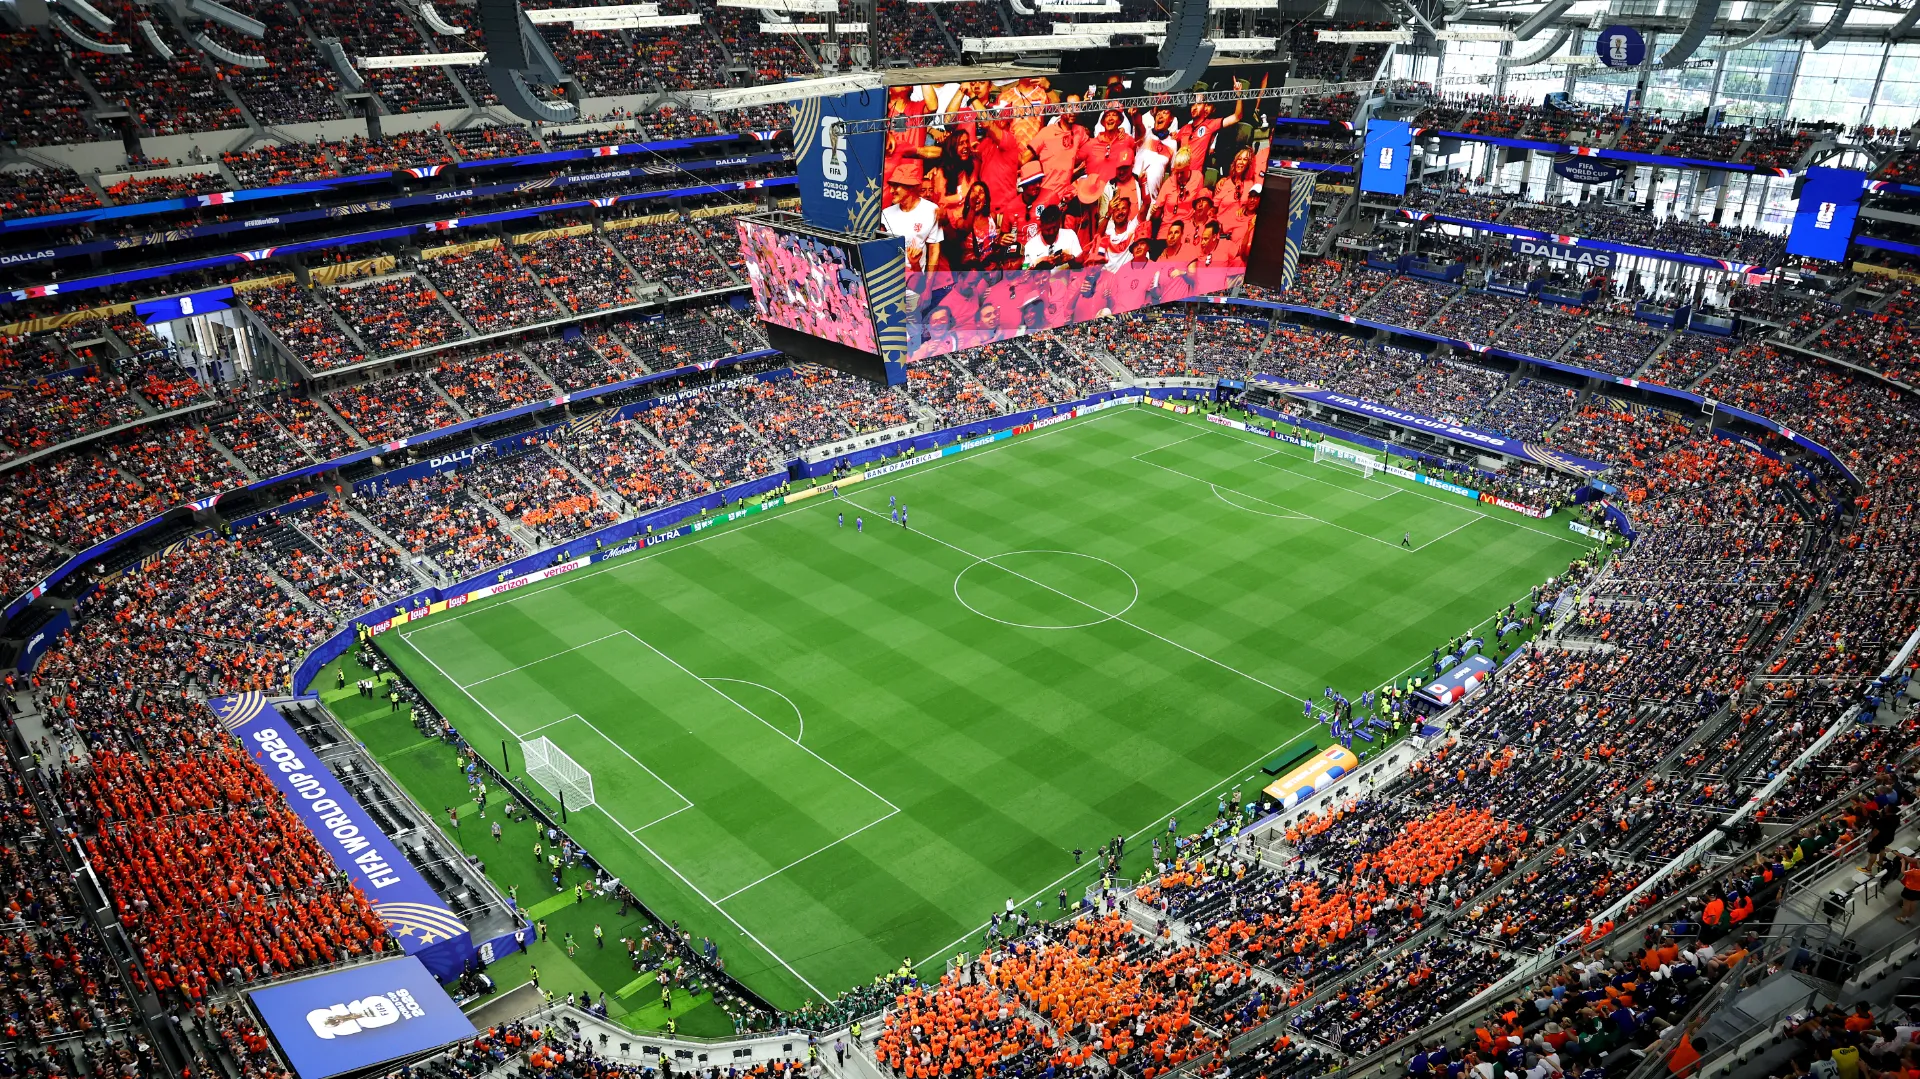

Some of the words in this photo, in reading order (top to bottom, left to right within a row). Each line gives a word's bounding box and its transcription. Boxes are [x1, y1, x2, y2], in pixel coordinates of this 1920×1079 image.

[715, 157, 747, 166] DALLAS
[1578, 162, 1594, 170] FIFA
[568, 174, 580, 183] FIFA
[580, 172, 600, 182] WORLD
[601, 172, 611, 180] CUP
[612, 170, 631, 178] 2026
[829, 167, 841, 176] FIFA
[1565, 166, 1592, 176] WORLD
[823, 181, 839, 190] WORLD
[839, 183, 849, 191] CUP
[435, 189, 473, 201] DALLAS
[823, 188, 849, 201] 2026
[0, 250, 55, 264] DALLAS
[1520, 242, 1610, 267] DALLAS
[660, 394, 678, 405] FIFA
[1033, 410, 1072, 430] McDonald's
[1278, 413, 1289, 421] FIFA
[1326, 394, 1359, 407] FIFA
[1360, 403, 1416, 422] WORLD
[1413, 418, 1448, 431] CUP
[1446, 427, 1506, 446] 2026
[960, 435, 995, 452] Hisense
[1275, 432, 1300, 445] ULTRA
[430, 443, 493, 468] DALLAS
[866, 467, 888, 479] BANK
[889, 463, 899, 472] OF
[899, 453, 932, 469] AMERICA
[816, 483, 834, 493] TEXAS
[1424, 476, 1469, 497] Hisense
[602, 541, 637, 561] Michelob
[646, 529, 681, 546] ULTRA
[543, 561, 579, 578] verizon
[491, 577, 528, 594] verizon
[449, 594, 467, 608] Lay's
[410, 607, 428, 621] Lay's
[373, 620, 391, 636] Lay's
[253, 728, 306, 773] 2026
[288, 773, 327, 800] CUP
[311, 798, 371, 855] WORLD
[354, 849, 401, 889] FIFA
[386, 991, 400, 1003] CUP
[396, 988, 426, 1018] 2026
[374, 1002, 389, 1016] FIFA
[394, 1001, 413, 1020] WORLD
